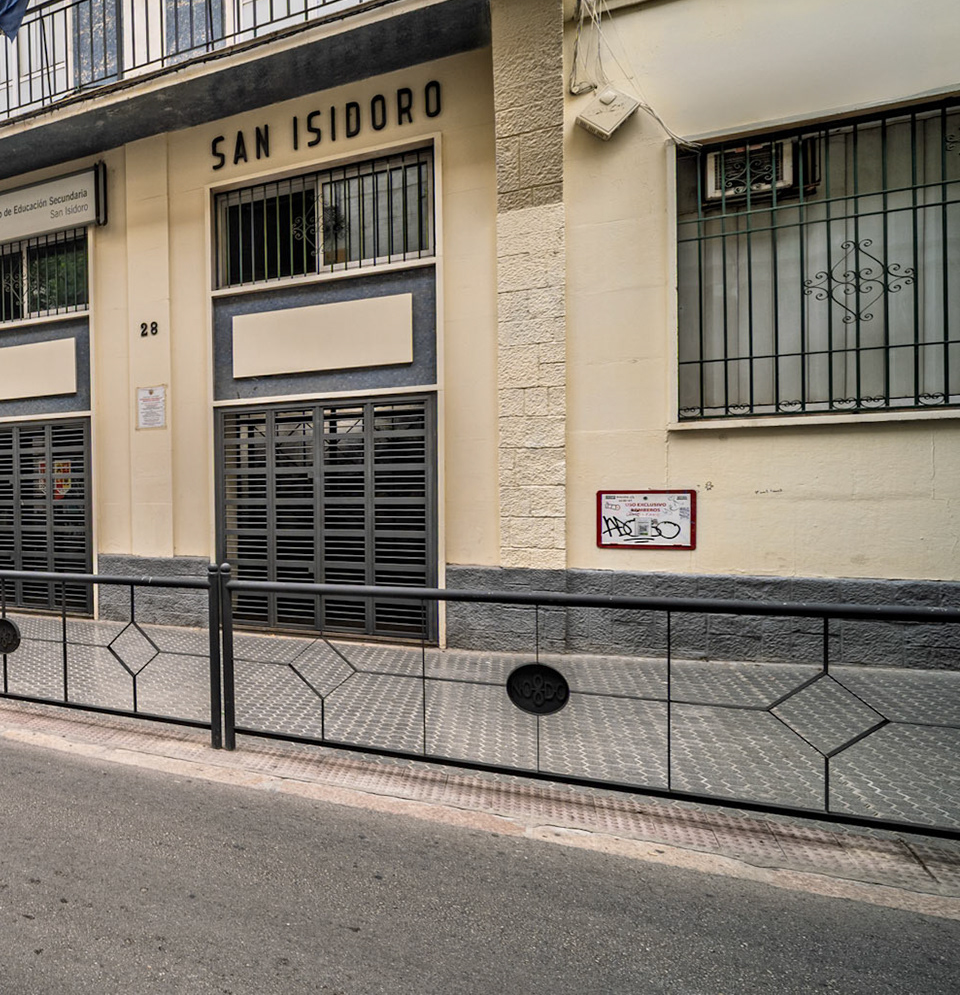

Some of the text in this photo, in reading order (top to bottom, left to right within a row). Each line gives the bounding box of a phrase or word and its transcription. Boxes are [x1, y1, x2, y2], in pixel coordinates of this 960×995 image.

[211, 80, 441, 170] SAN ISIDORO
[3, 207, 12, 217] de
[13, 199, 47, 215] Educación
[49, 189, 88, 206] Secundaria
[50, 203, 89, 219] San Isidoro
[140, 321, 158, 337] 28
